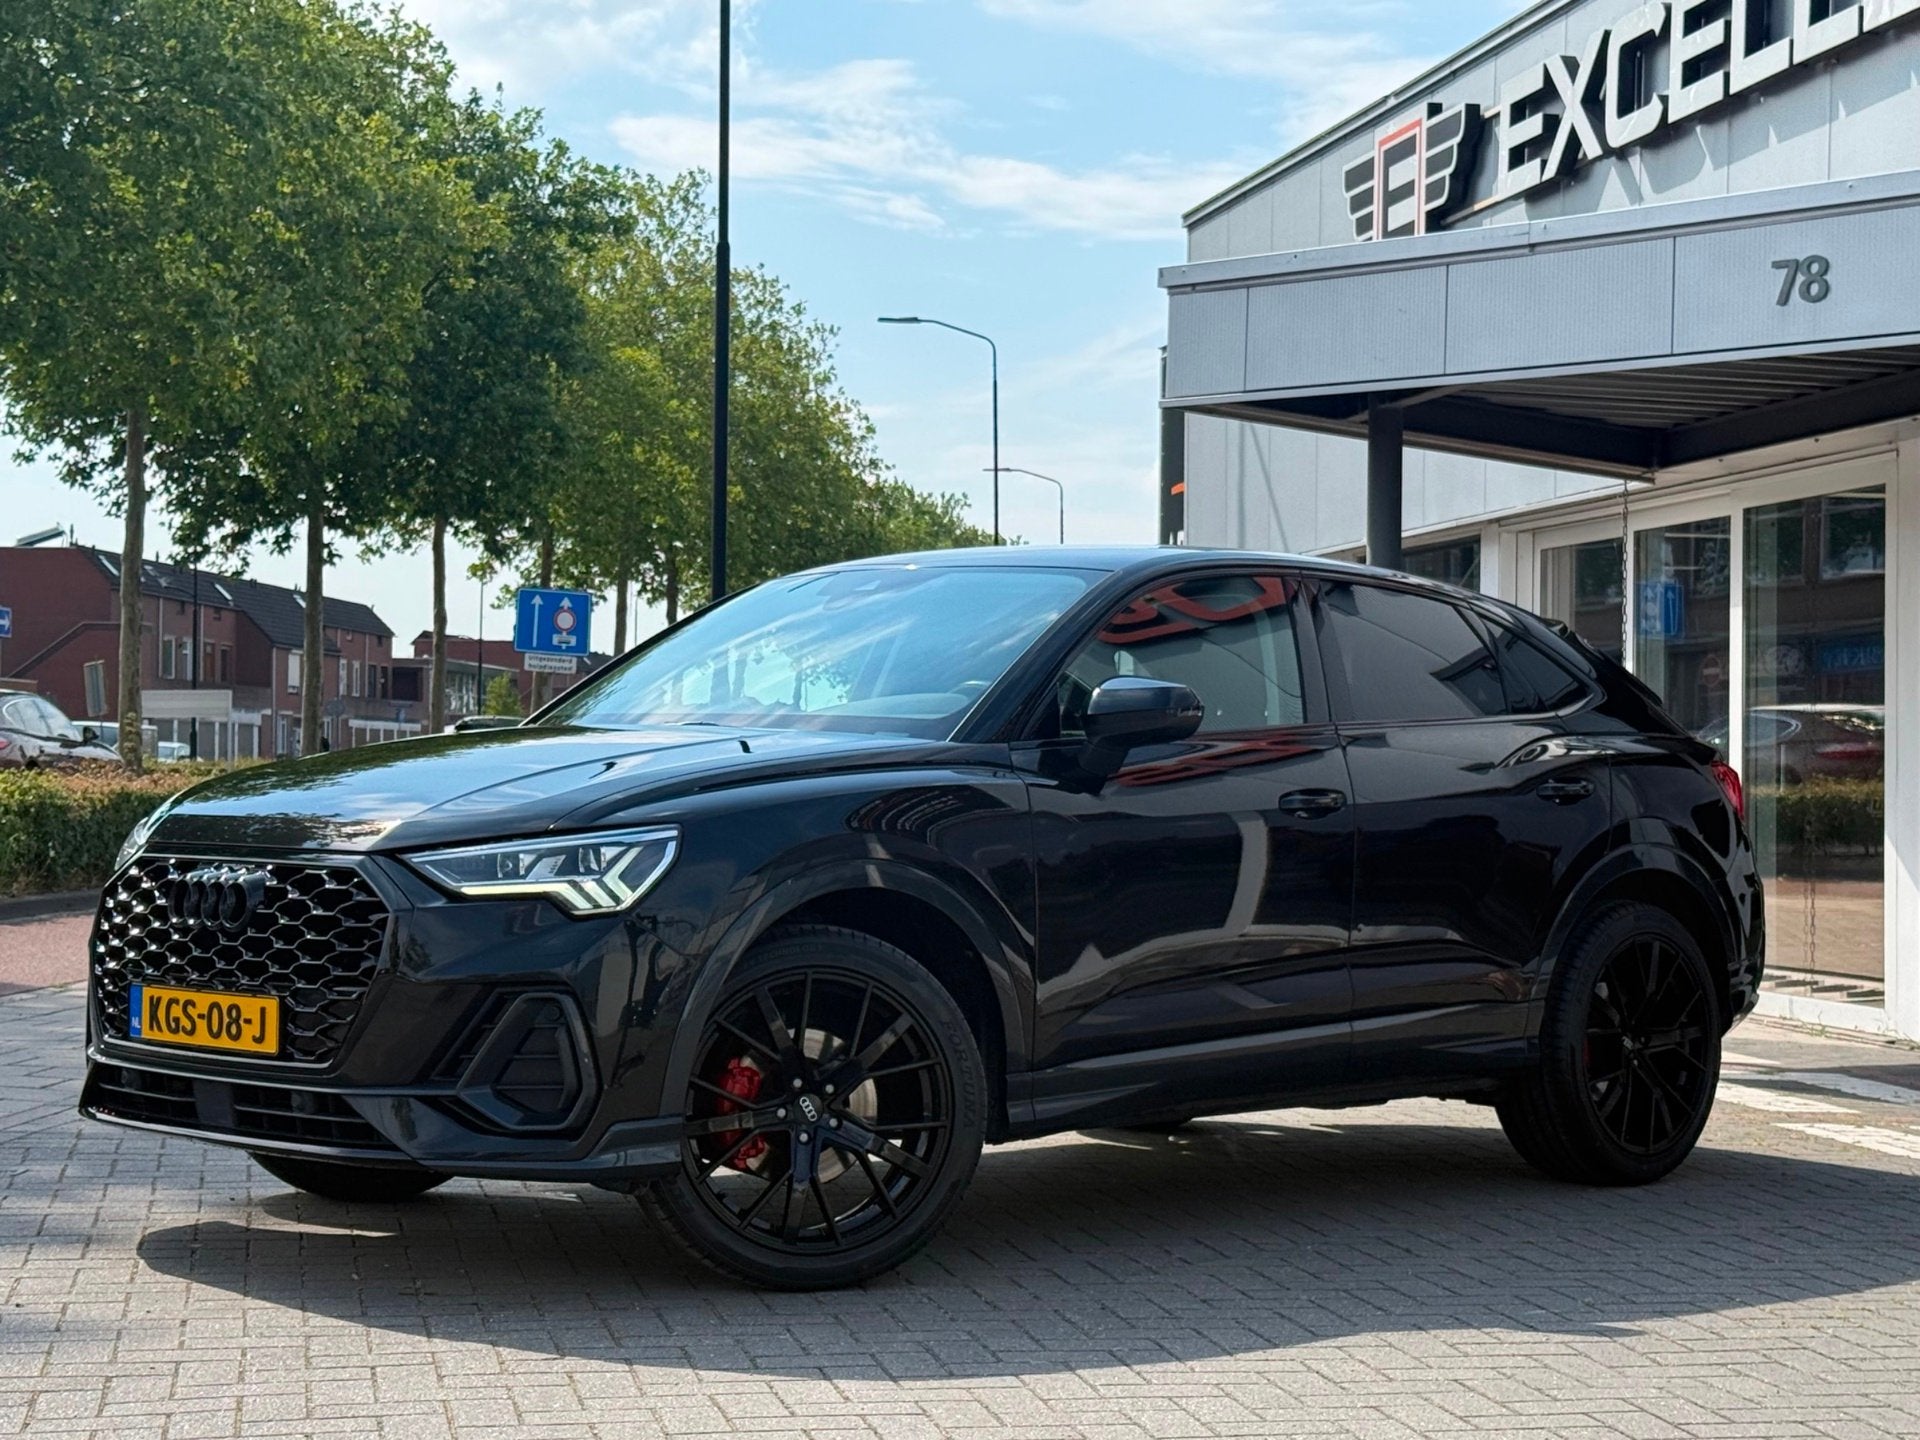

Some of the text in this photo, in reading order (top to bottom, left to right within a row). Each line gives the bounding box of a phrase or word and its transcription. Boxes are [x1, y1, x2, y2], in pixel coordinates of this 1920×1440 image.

[1498, 0, 1920, 201] EXCELL
[1771, 255, 1830, 307] 78
[131, 1016, 141, 1028] NL
[148, 994, 267, 1045] KGS-08-J
[940, 1019, 977, 1129] FORTUNA
